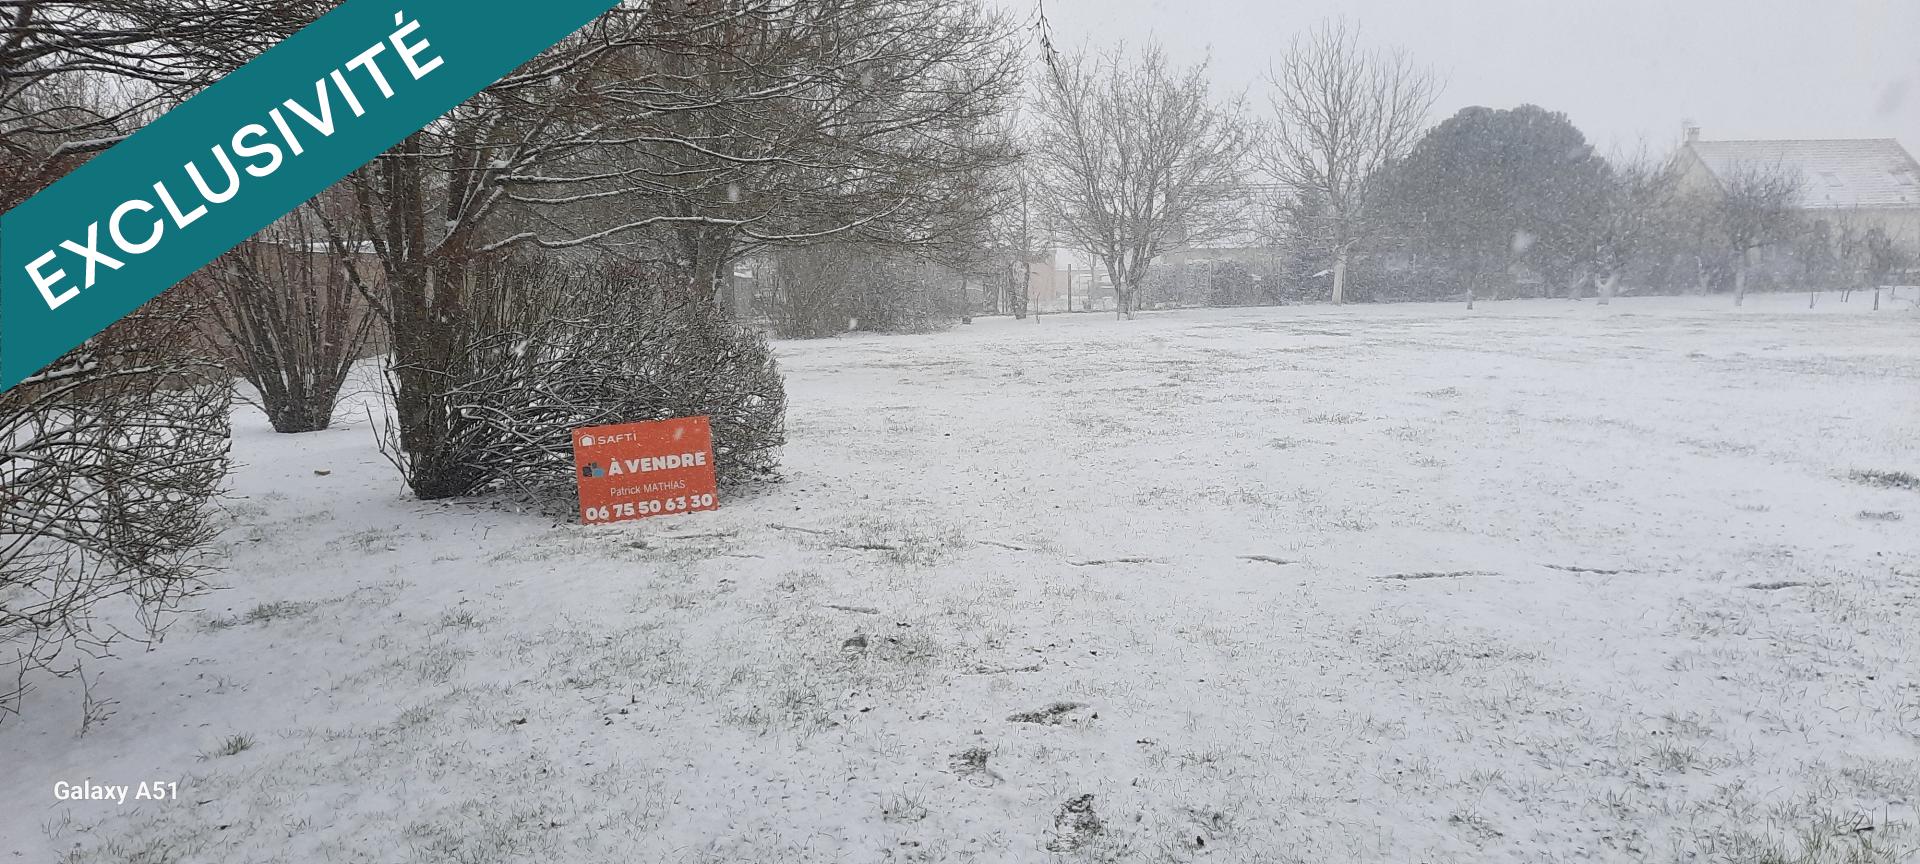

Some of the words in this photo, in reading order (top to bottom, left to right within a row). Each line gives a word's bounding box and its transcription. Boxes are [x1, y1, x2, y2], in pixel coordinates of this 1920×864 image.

[608, 457, 623, 476] À
[625, 452, 707, 474] VENDRE
[610, 485, 640, 497] Patrick
[643, 480, 686, 493] MATHIAS
[585, 505, 609, 521] 06
[612, 502, 635, 518] 75
[638, 499, 661, 514] 50
[665, 496, 687, 511] 63
[690, 493, 713, 508] 30
